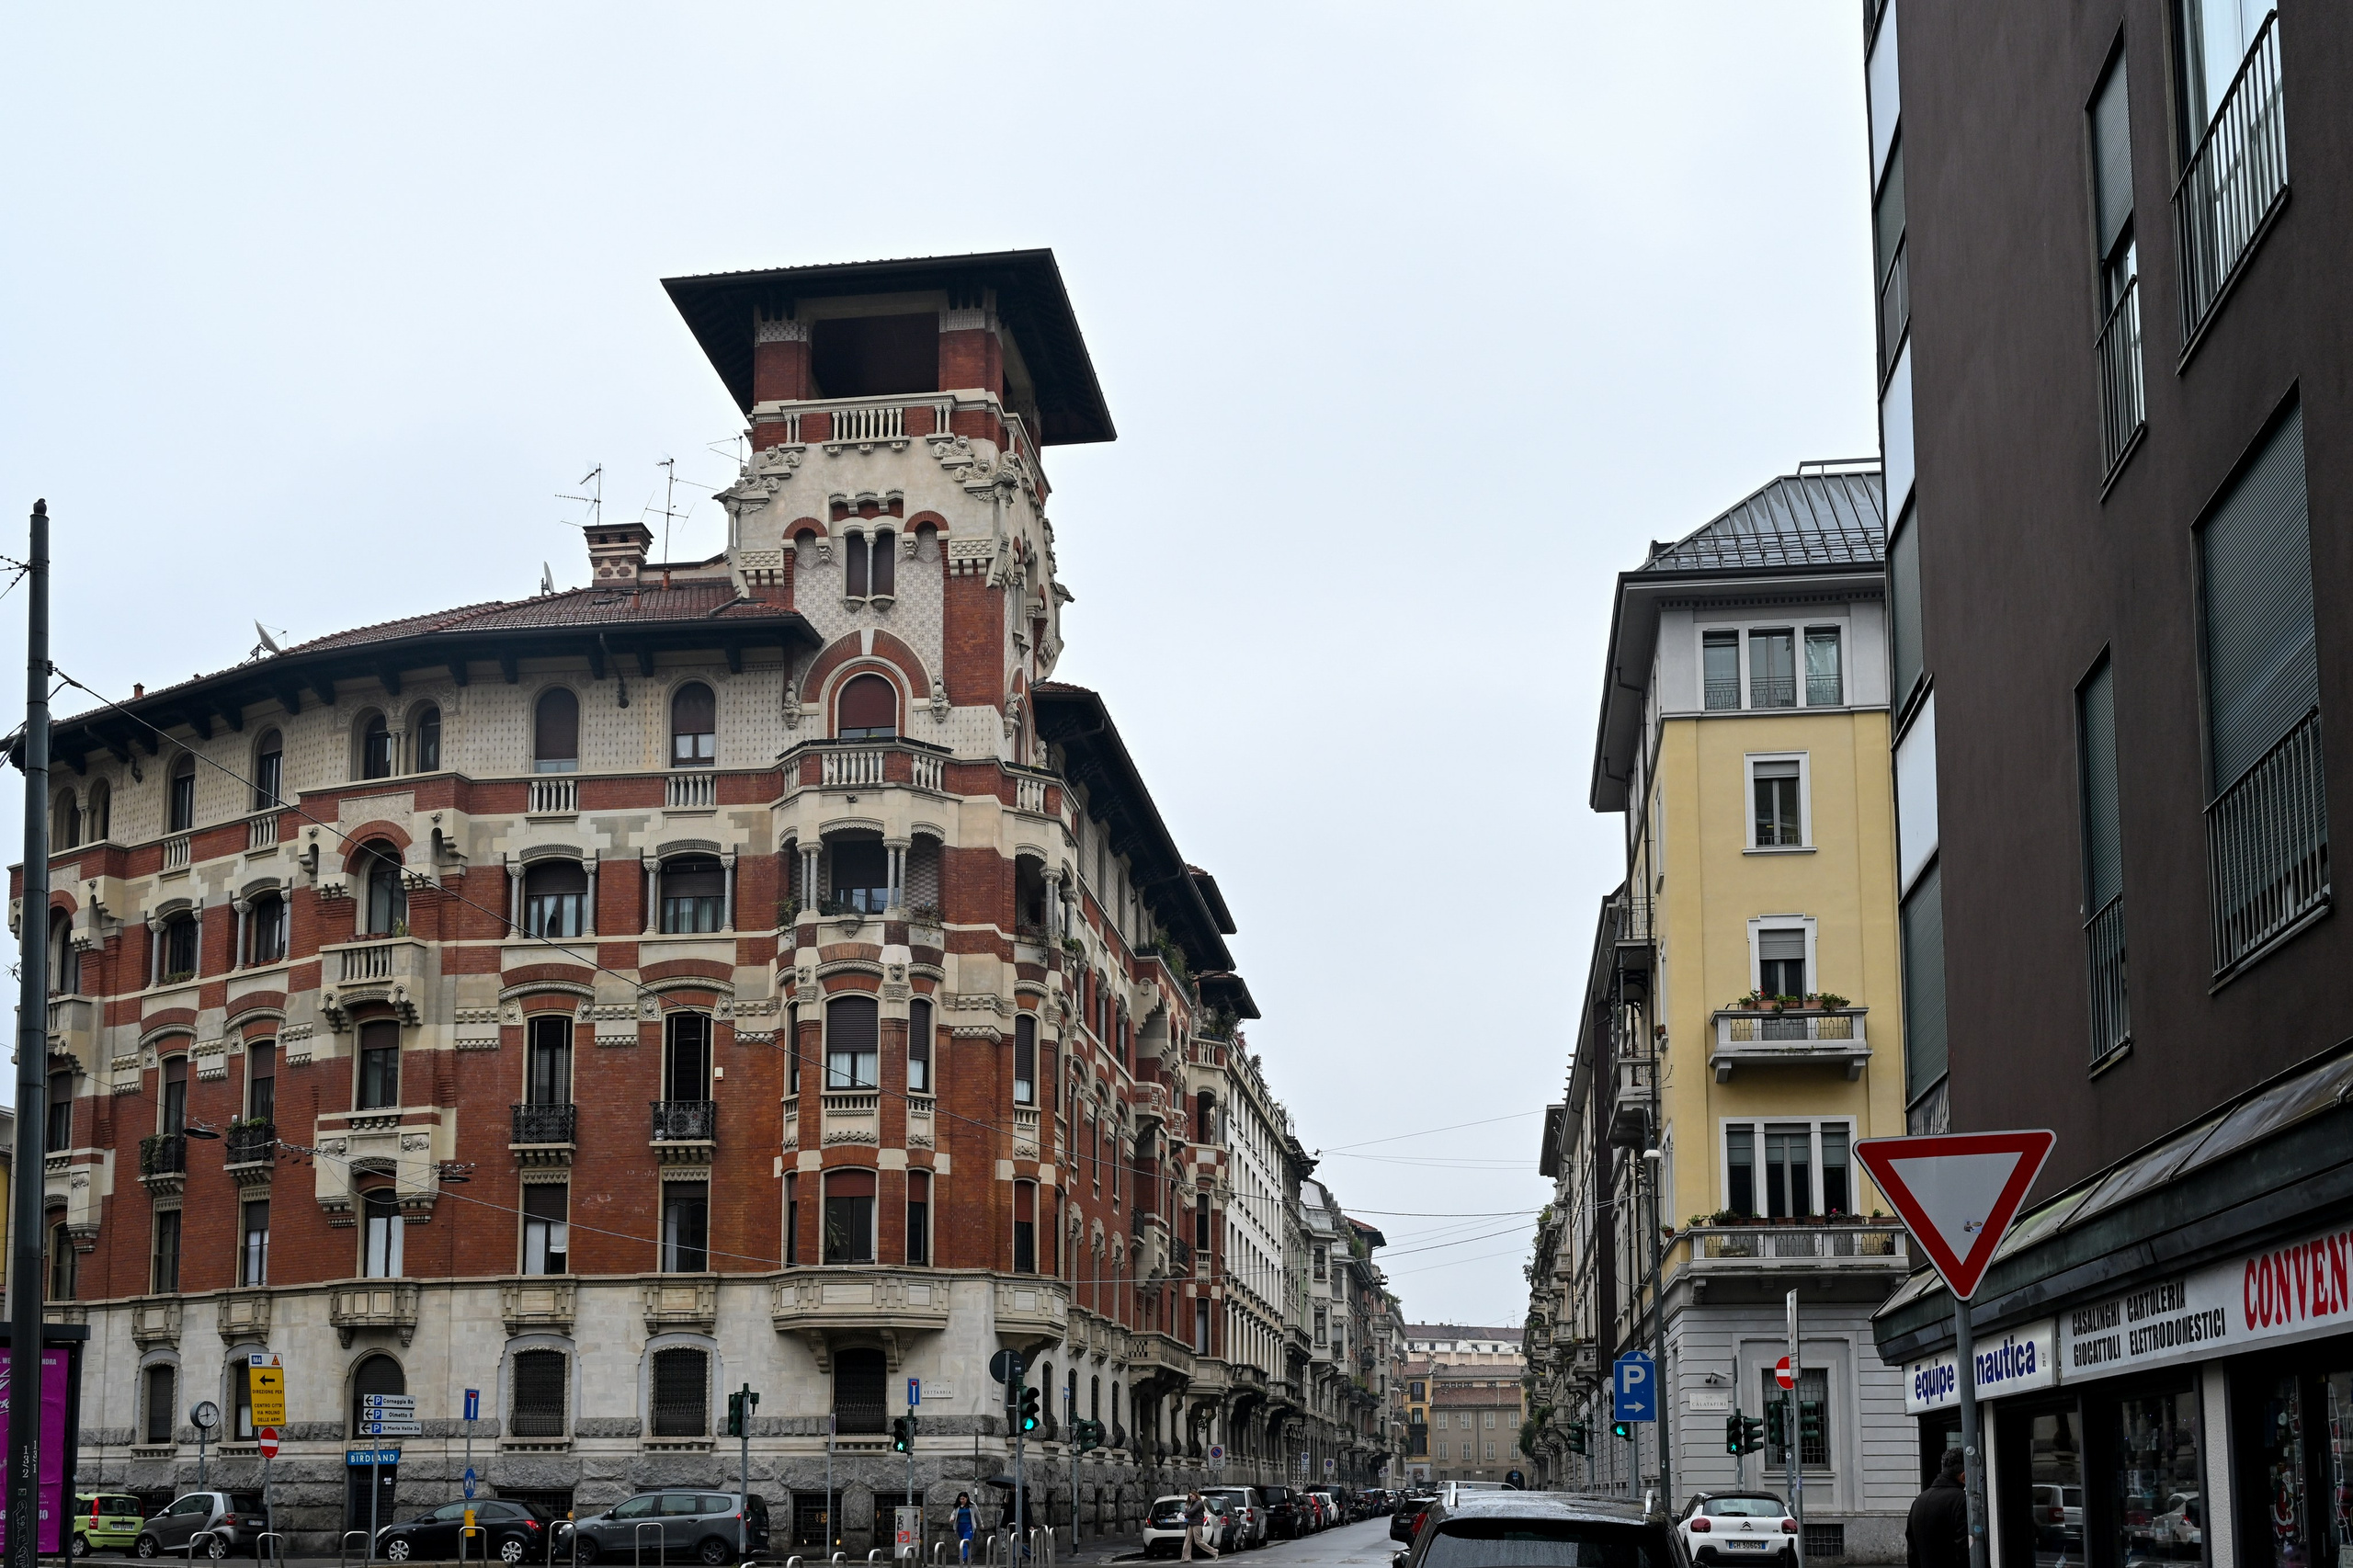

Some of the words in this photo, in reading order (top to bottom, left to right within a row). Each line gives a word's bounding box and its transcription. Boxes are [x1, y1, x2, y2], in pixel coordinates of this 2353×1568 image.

[2244, 1230, 2353, 1331] CONVEN
[2072, 1301, 2120, 1337] CASALINGHI
[2126, 1281, 2186, 1323] CARTOLERIA
[1976, 1335, 2037, 1385] nautica
[2074, 1335, 2121, 1368] GIOCATTOLI
[2129, 1307, 2226, 1356] ELETTRODOMESTICI
[1623, 1365, 1646, 1393] P
[350, 1454, 395, 1463] BIRDLAND
